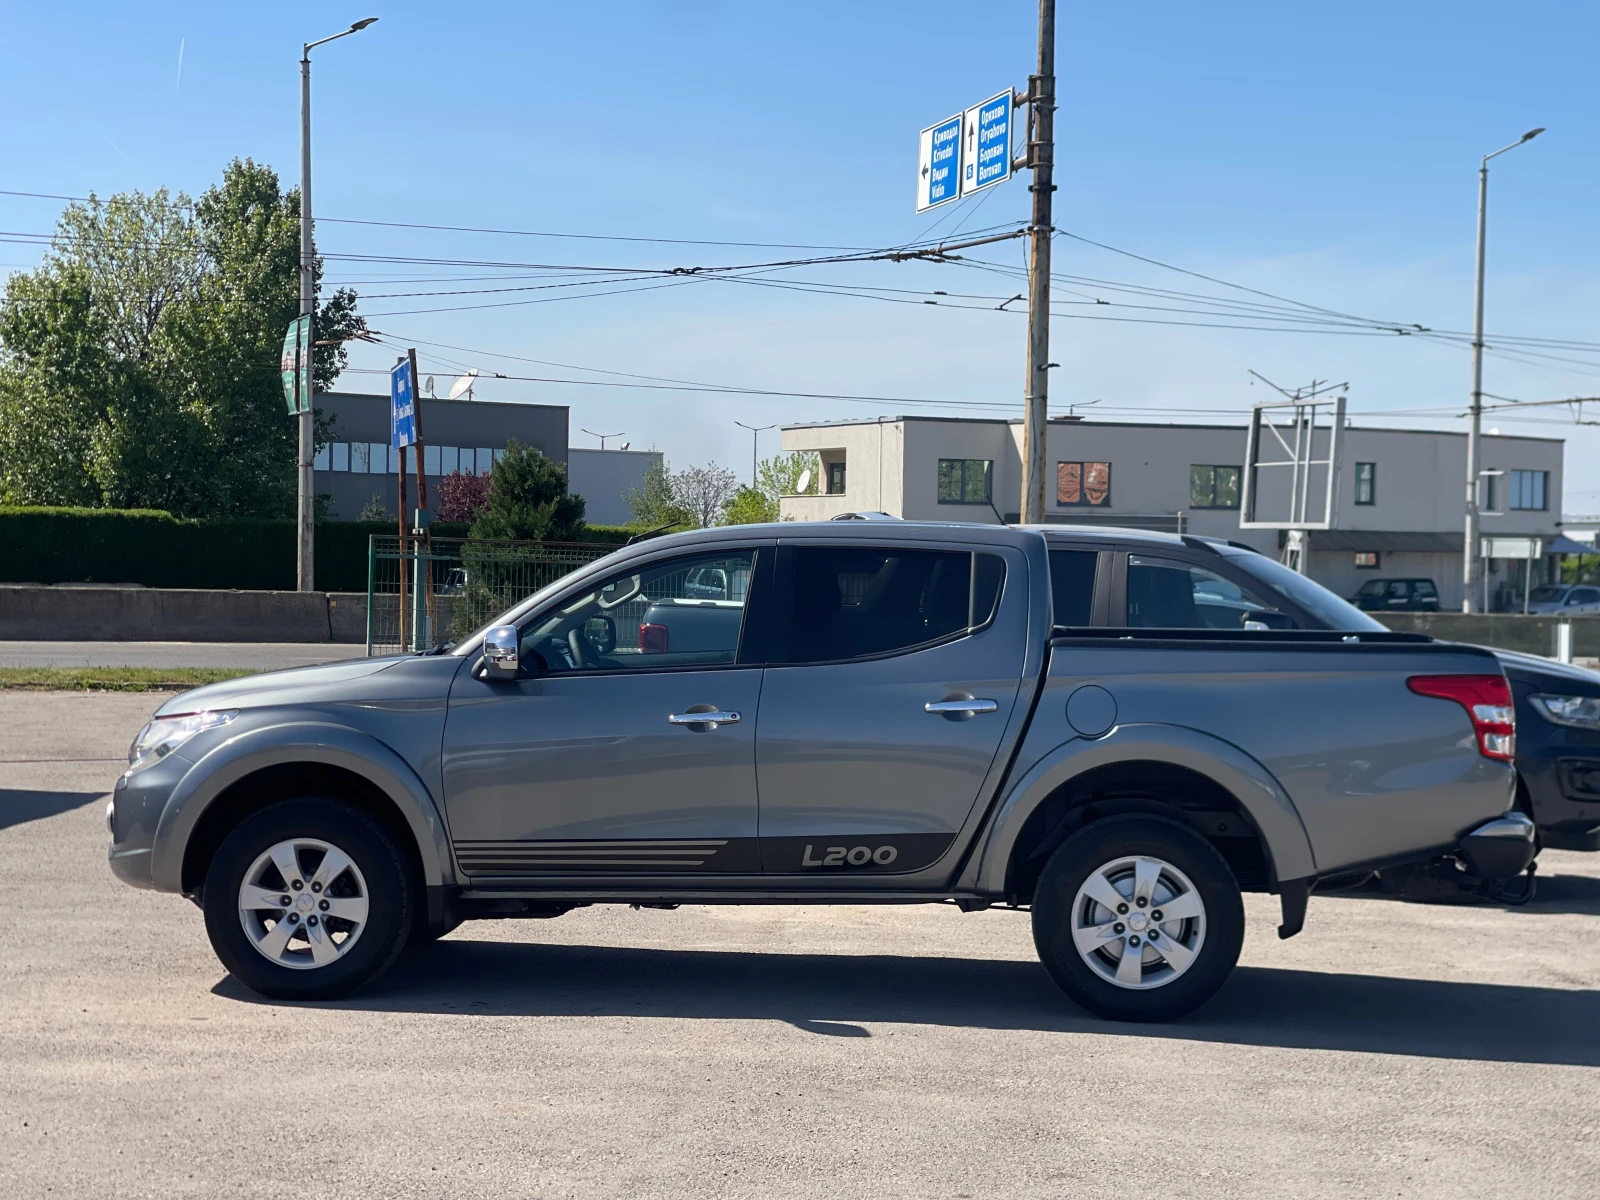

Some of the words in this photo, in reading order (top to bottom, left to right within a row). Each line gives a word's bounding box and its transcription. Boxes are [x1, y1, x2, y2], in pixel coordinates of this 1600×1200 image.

[933, 143, 953, 163] Krivodol
[980, 143, 1004, 163] Борован
[932, 167, 949, 182] Видин
[979, 162, 1002, 181] Borovan
[932, 185, 945, 199] Vidin
[802, 844, 898, 867] L200
